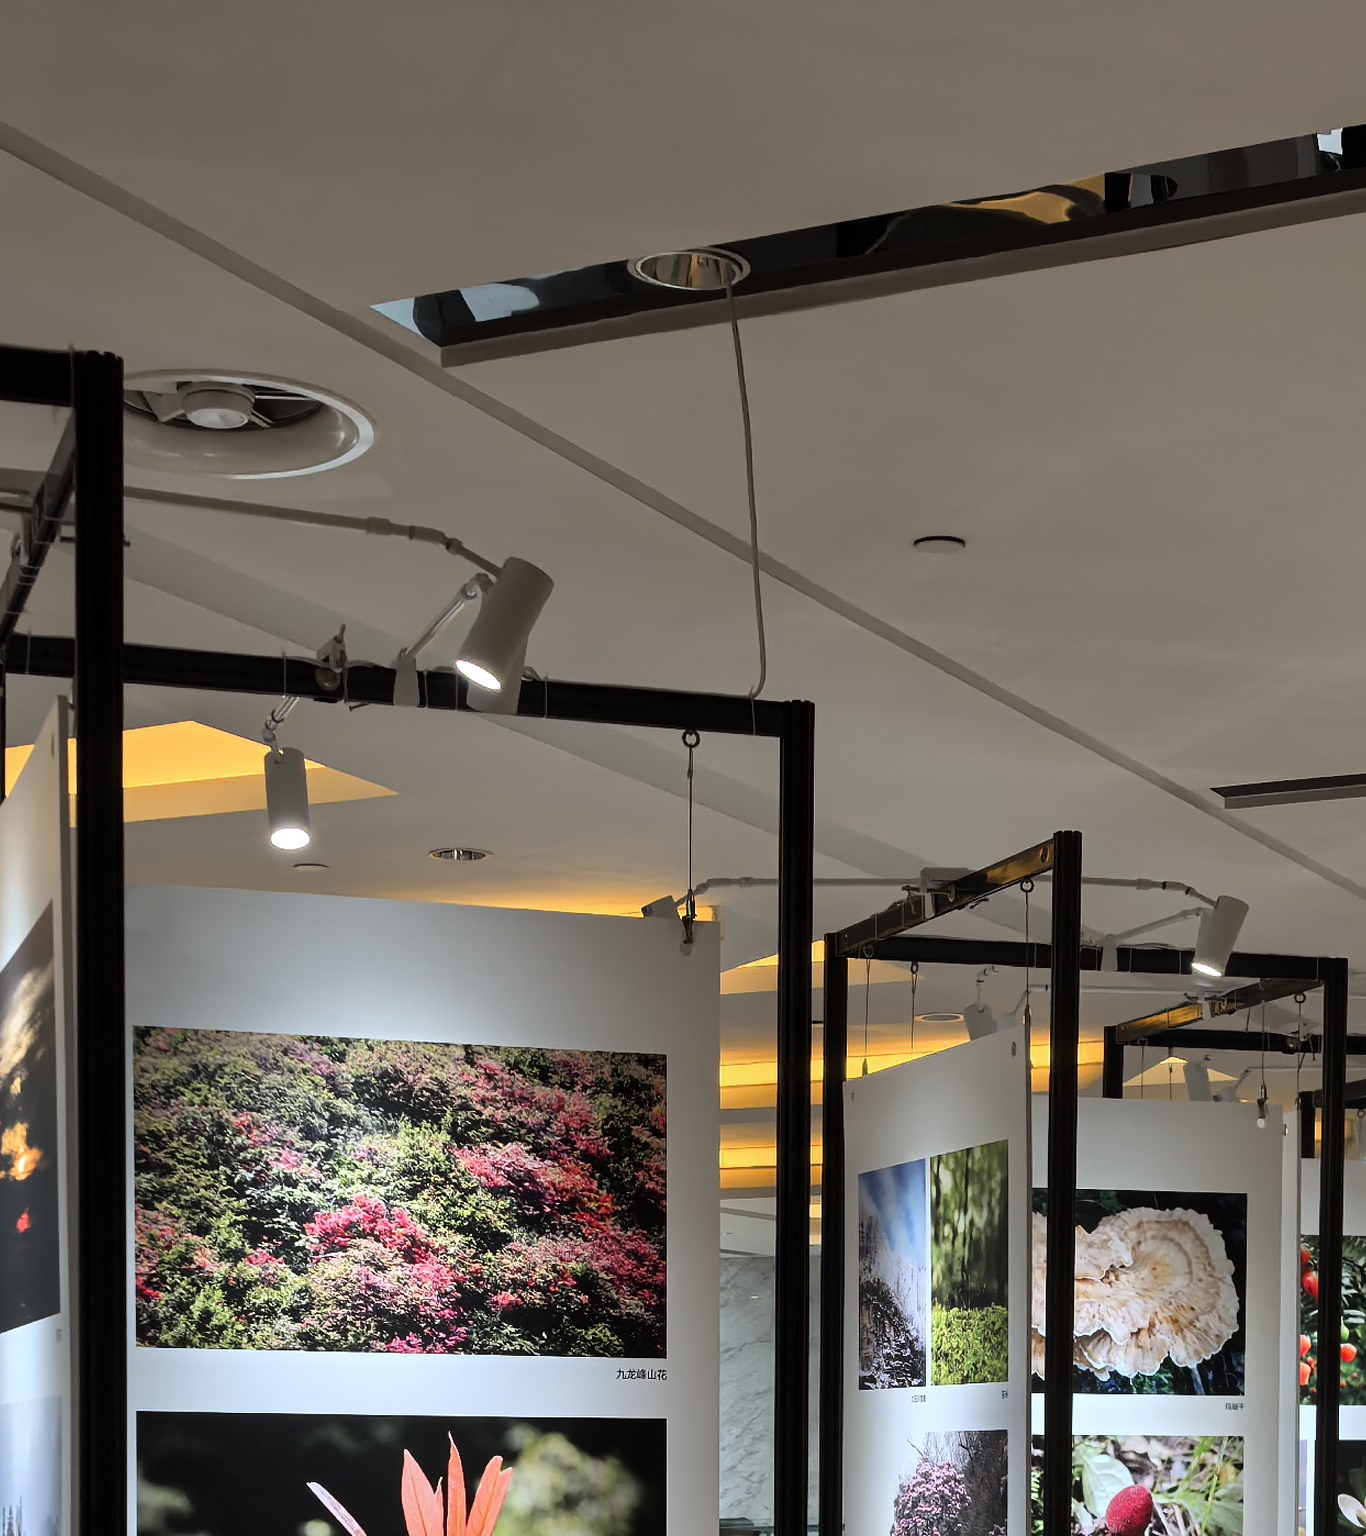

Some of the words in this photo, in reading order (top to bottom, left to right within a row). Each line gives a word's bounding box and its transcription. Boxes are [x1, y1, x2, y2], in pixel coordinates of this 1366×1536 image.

[616, 1368, 668, 1380] 九龙峰山花
